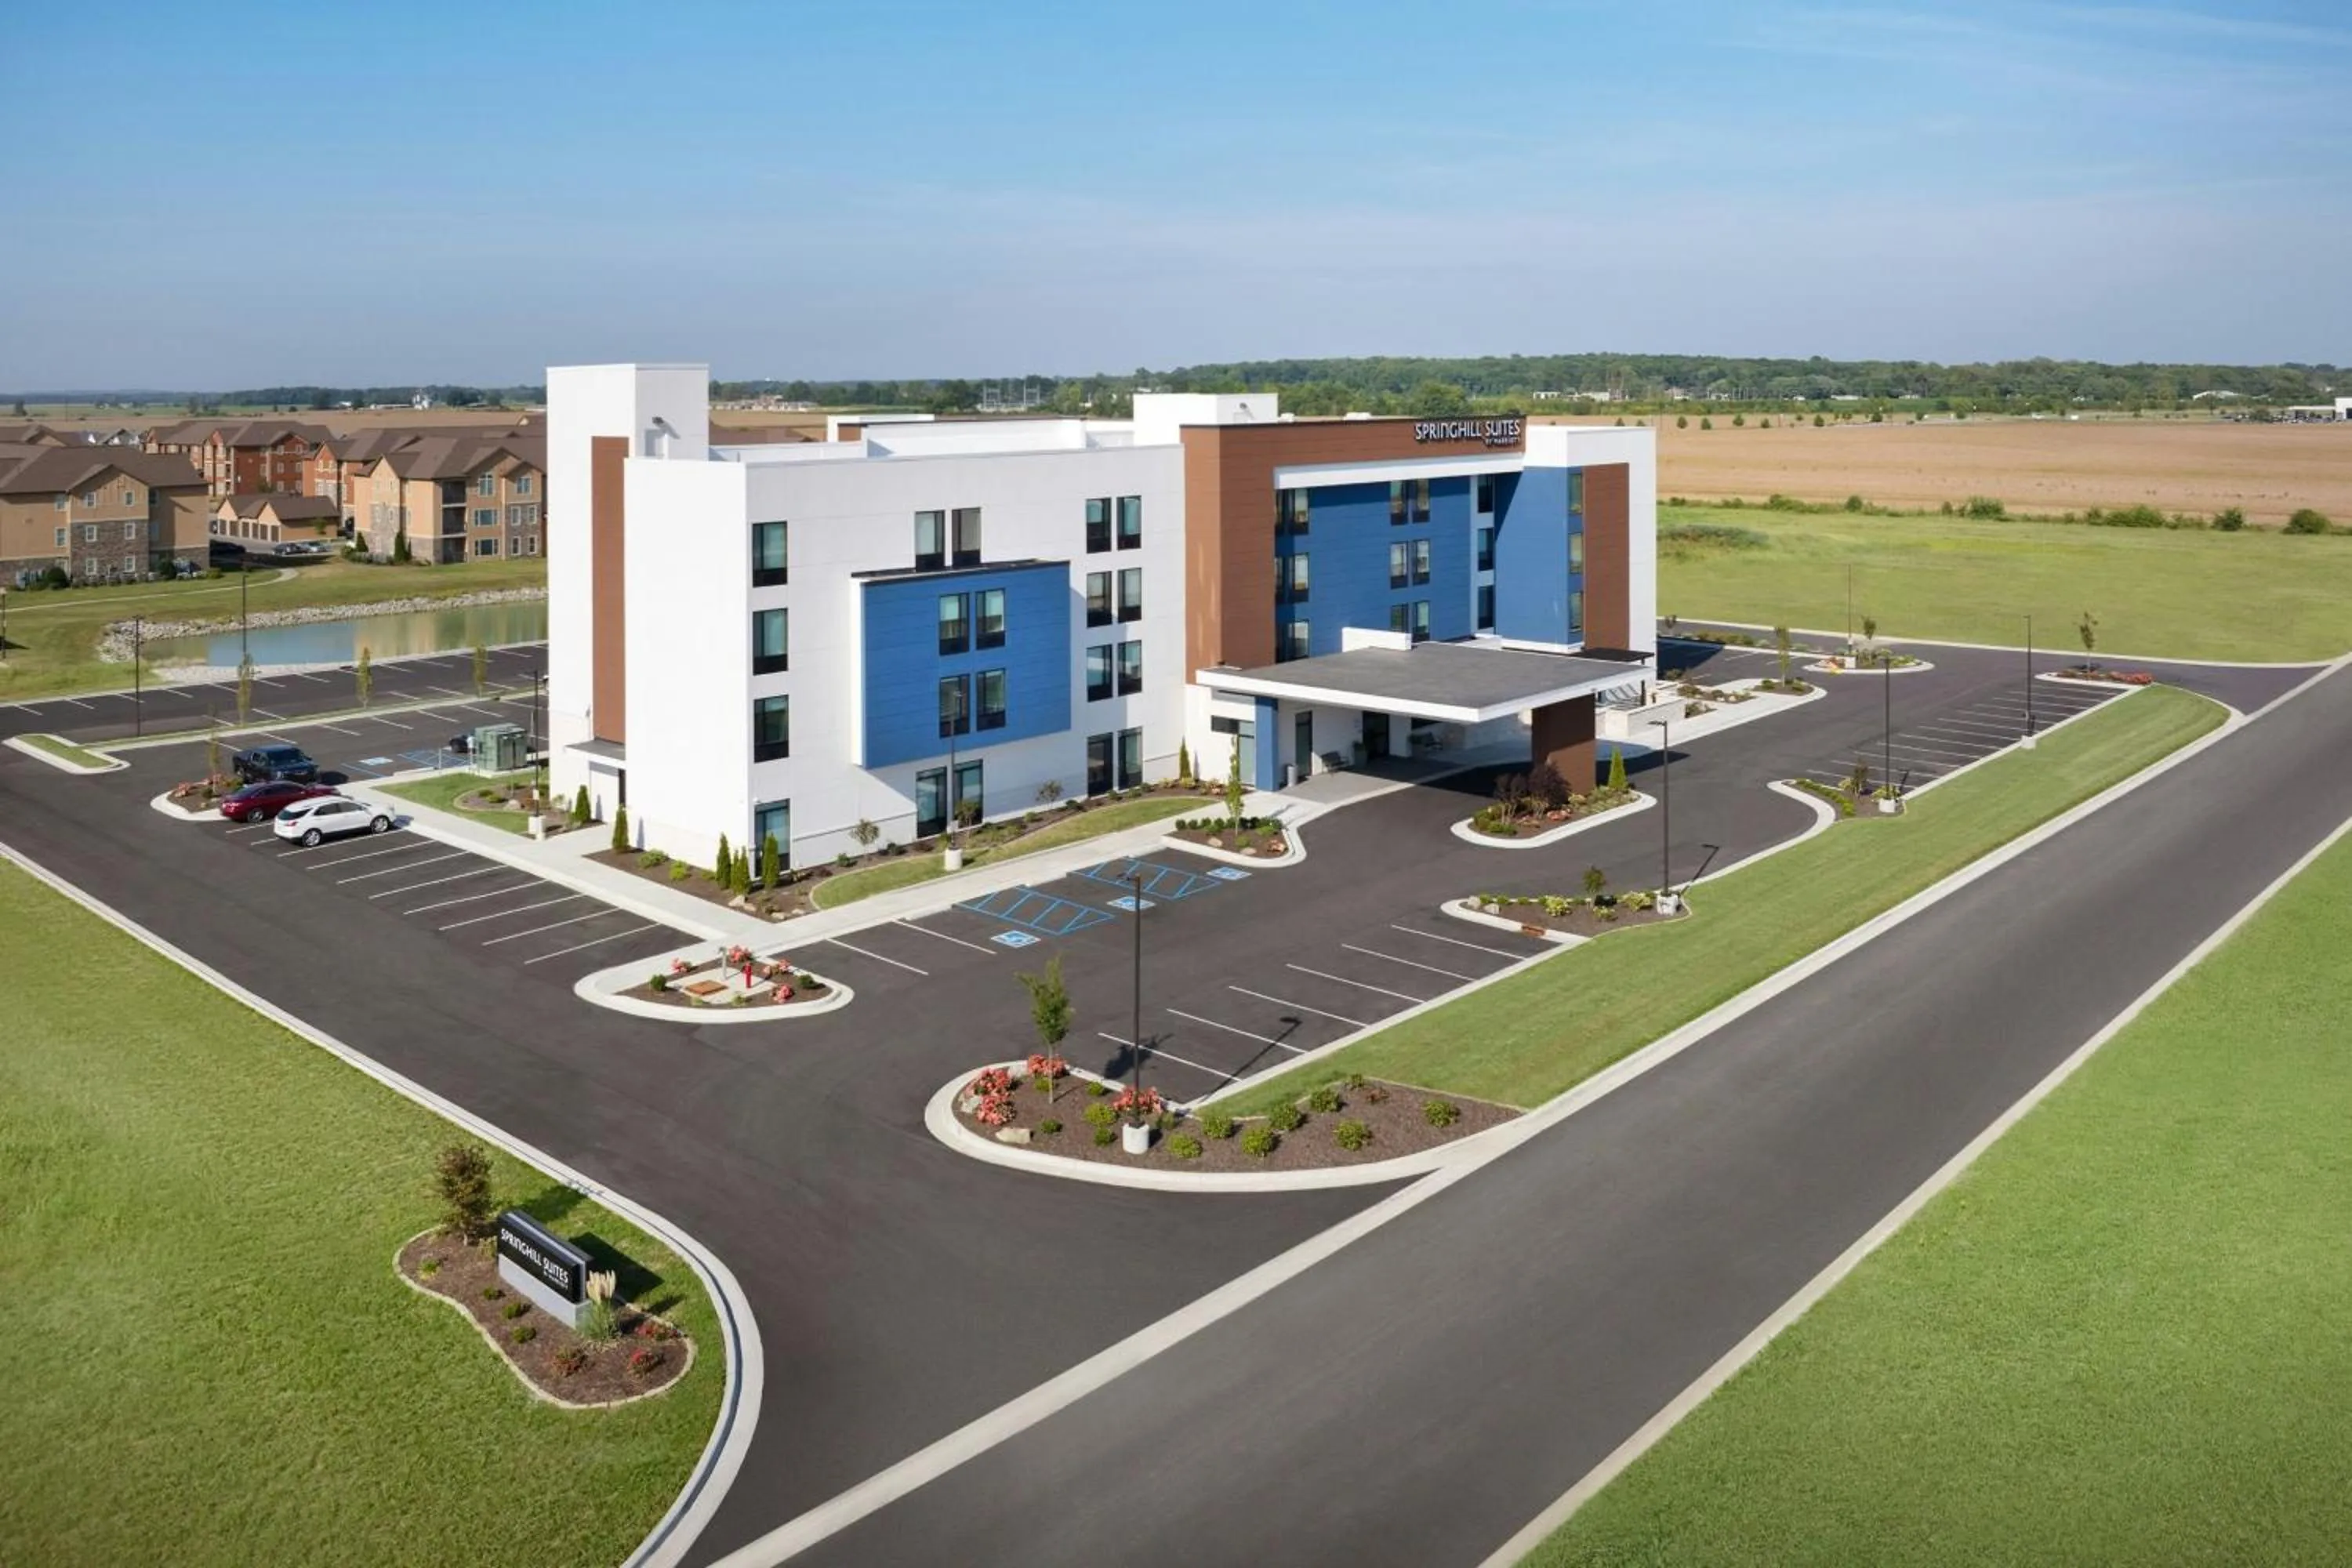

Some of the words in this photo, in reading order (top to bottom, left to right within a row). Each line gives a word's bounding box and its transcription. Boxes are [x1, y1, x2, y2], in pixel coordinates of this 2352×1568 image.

[1415, 421, 1482, 439] SPRINGHILL
[1485, 419, 1521, 436] SUITES
[501, 1228, 542, 1266] SPRINGHILL
[543, 1257, 568, 1283] SUITES
